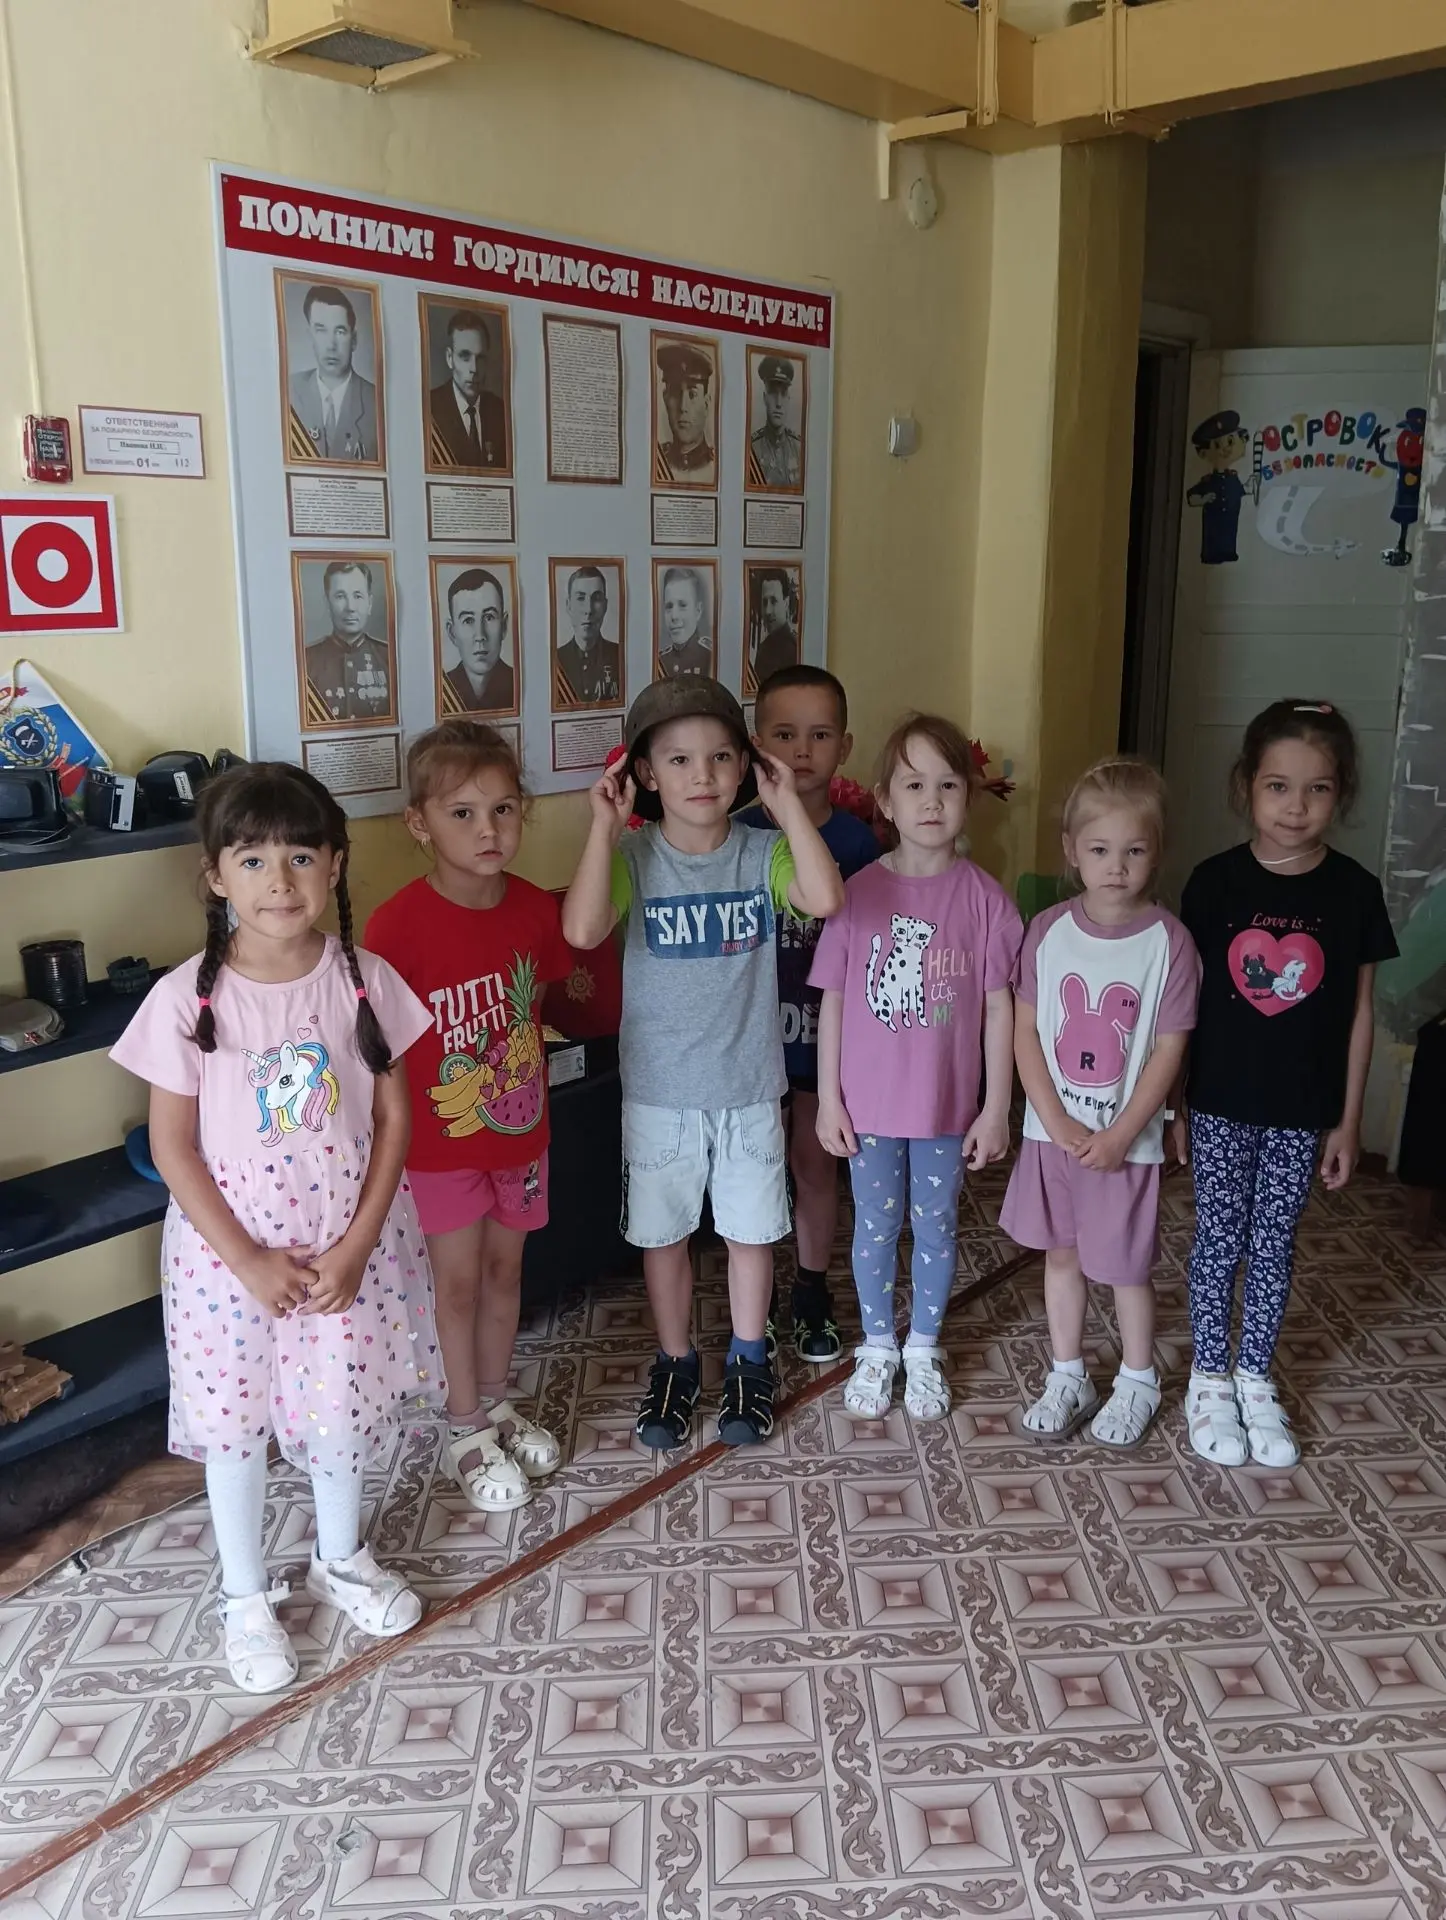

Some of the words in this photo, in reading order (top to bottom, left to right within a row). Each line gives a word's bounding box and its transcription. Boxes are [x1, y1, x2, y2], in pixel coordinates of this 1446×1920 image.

[238, 193, 435, 262] ПОМНИМ!
[453, 235, 639, 299] ГОРДИМСЯ!
[652, 275, 826, 332] НАСЛЕДУЕМ!
[105, 417, 179, 429] ОТВЕТСТВЕННЫЙ
[1262, 410, 1391, 453] ОСТРОВОК
[142, 429, 194, 439] БЕЗОПАСНОСТЬ
[136, 458, 150, 468] 01
[175, 458, 190, 468] 112
[1250, 912, 1287, 928] Love
[429, 972, 506, 1035] TUTTI
[1121, 998, 1136, 1009] BR
[443, 1003, 507, 1054] FRUTTI
[1079, 1051, 1096, 1071] R
